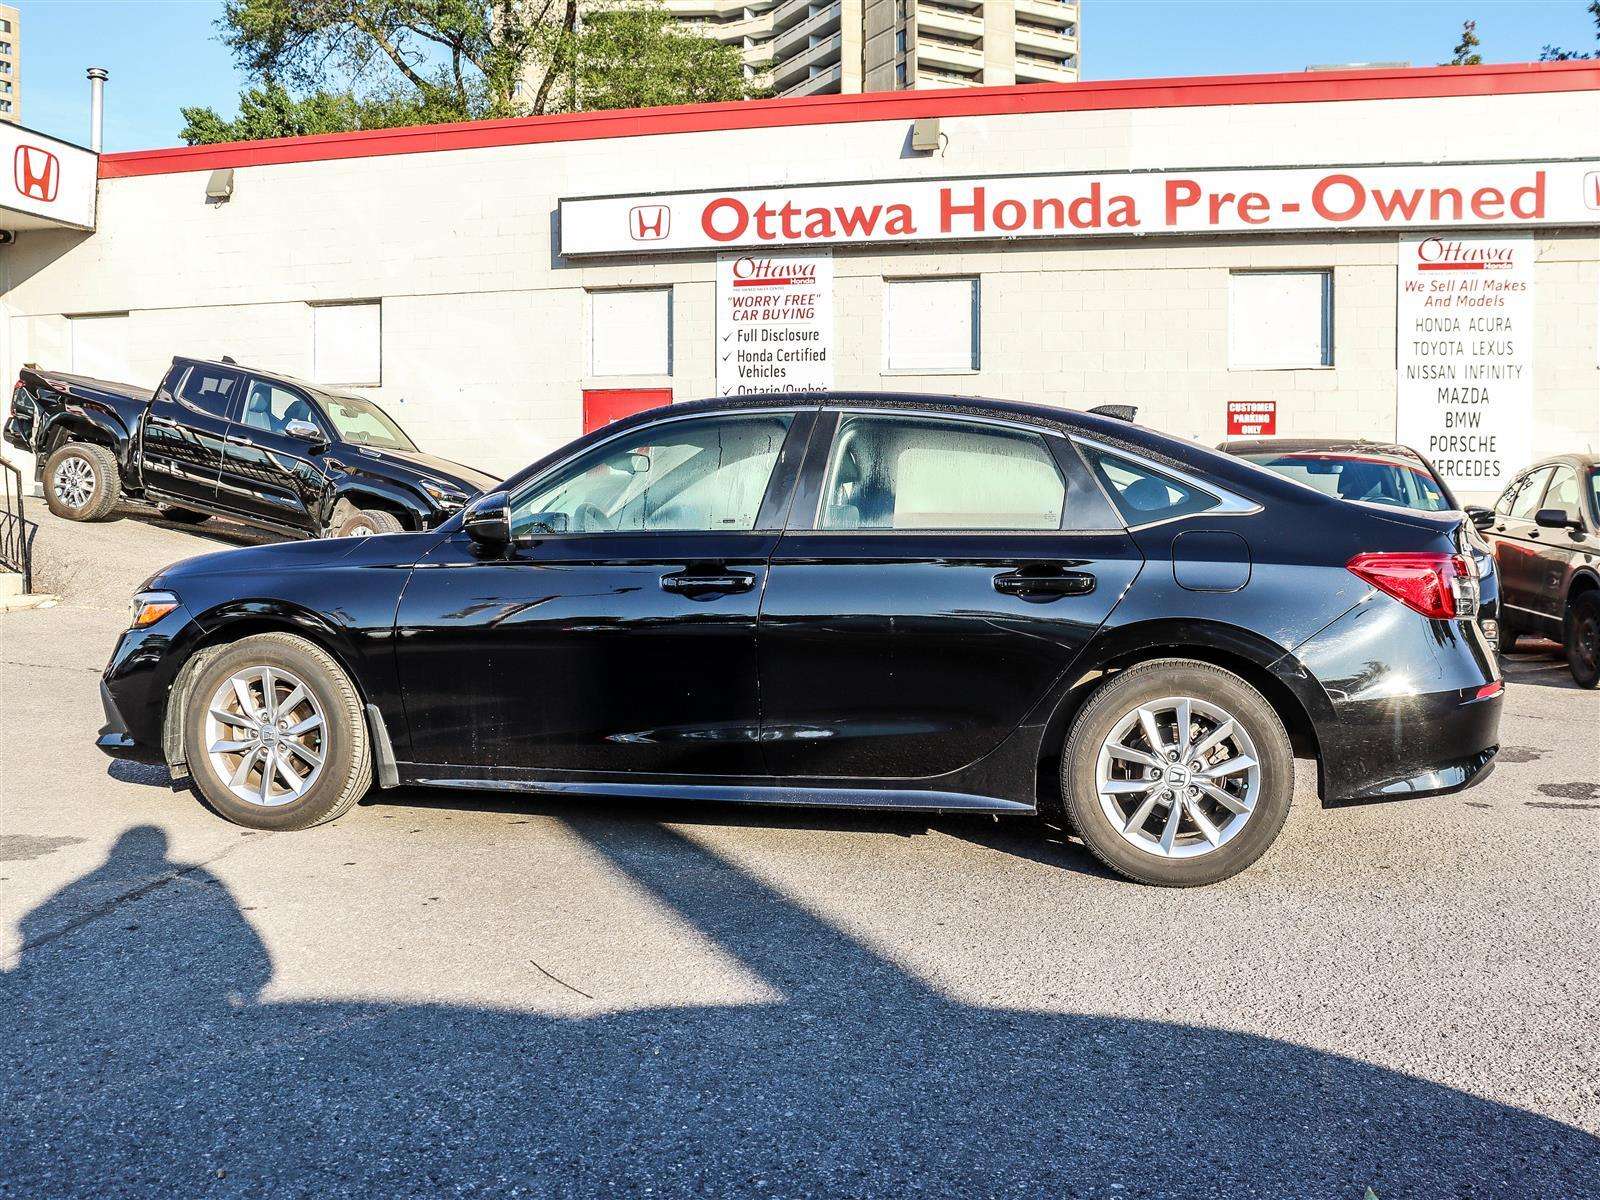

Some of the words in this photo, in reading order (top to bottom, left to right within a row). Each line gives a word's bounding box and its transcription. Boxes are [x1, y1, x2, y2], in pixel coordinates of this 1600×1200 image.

[701, 197, 917, 242] Ottawa
[940, 182, 1141, 233] Honda
[1165, 171, 1546, 226] Pre-Owned
[1418, 236, 1514, 262] Ottawa
[733, 256, 816, 279] Ottawa
[790, 277, 816, 285] Honda
[1405, 280, 1424, 292] We
[1430, 280, 1455, 292] Sell
[1459, 280, 1478, 292] All
[1483, 279, 1527, 291] Makes
[1424, 295, 1451, 307] And
[1456, 294, 1505, 306] Models
[732, 309, 758, 321] CAR
[762, 307, 815, 320] BUYING
[1415, 317, 1461, 332] HONDA
[1469, 317, 1512, 332] ACURA
[737, 329, 757, 342] Full
[761, 328, 820, 342] Disclosure
[737, 349, 773, 362] Honda
[776, 348, 826, 362] Certified
[1413, 341, 1463, 356] TOYOTA
[1472, 341, 1514, 356] LEXUS
[738, 364, 786, 378] Vehicles
[1406, 365, 1456, 379] NISSAN
[1465, 365, 1522, 379] INFINITY
[1437, 387, 1490, 404] MAZDA
[1230, 402, 1274, 412] CUSTOMER
[1233, 413, 1269, 424] PARKING
[1445, 412, 1481, 428] BMW
[1241, 425, 1262, 435] ONLY
[1430, 435, 1497, 453] PORSCHE
